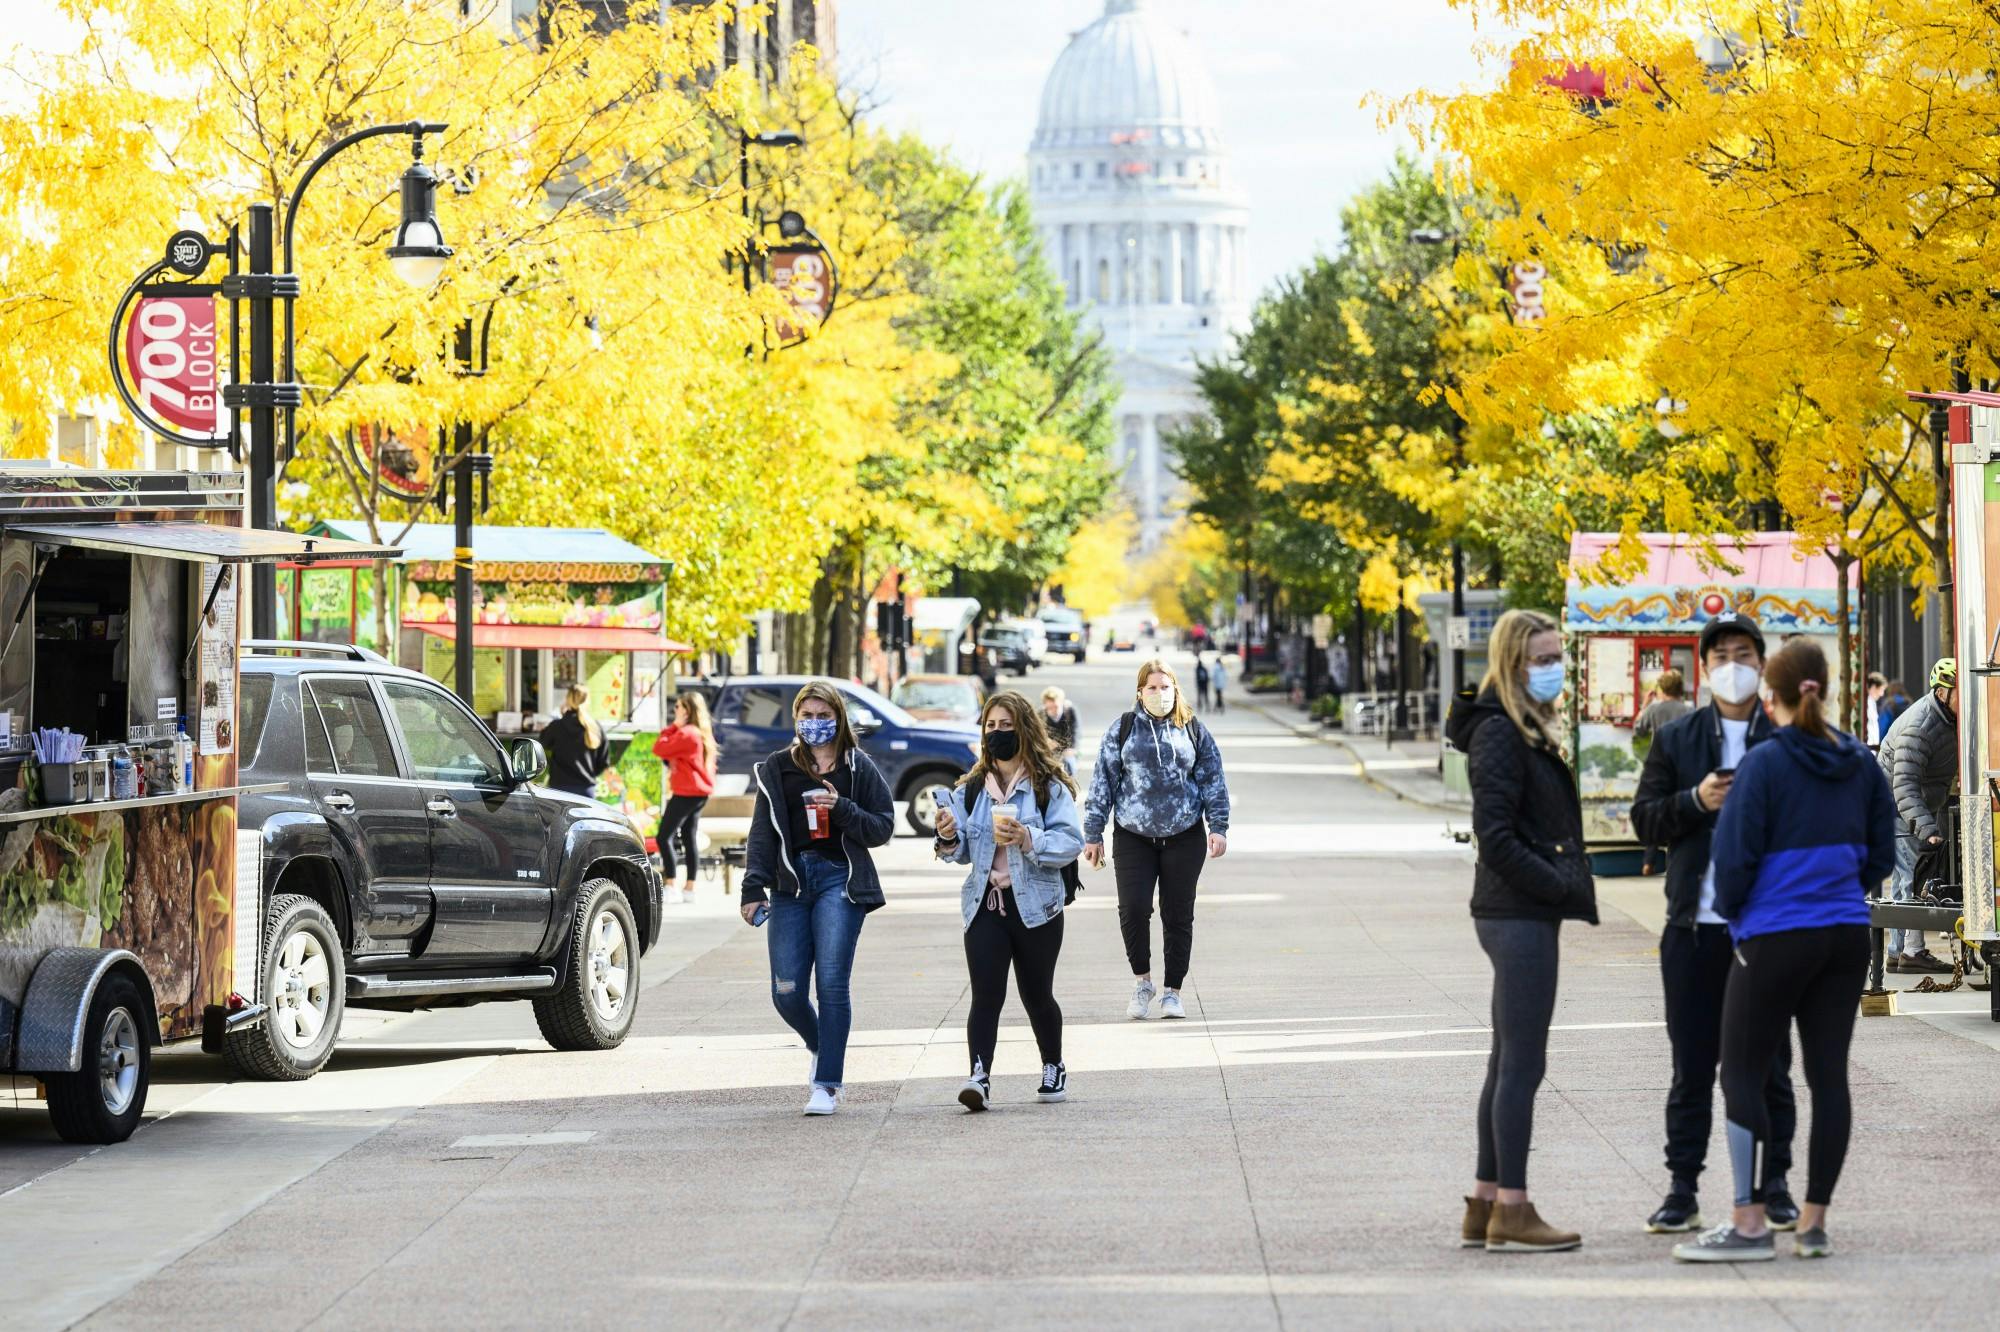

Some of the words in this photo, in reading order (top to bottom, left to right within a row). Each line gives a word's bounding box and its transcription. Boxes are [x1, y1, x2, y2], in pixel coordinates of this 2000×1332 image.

[174, 243, 198, 256] STATE
[140, 301, 186, 409] 700
[189, 322, 214, 411] BLOCK
[509, 562, 559, 581] COOL
[559, 562, 643, 583] DRINKS
